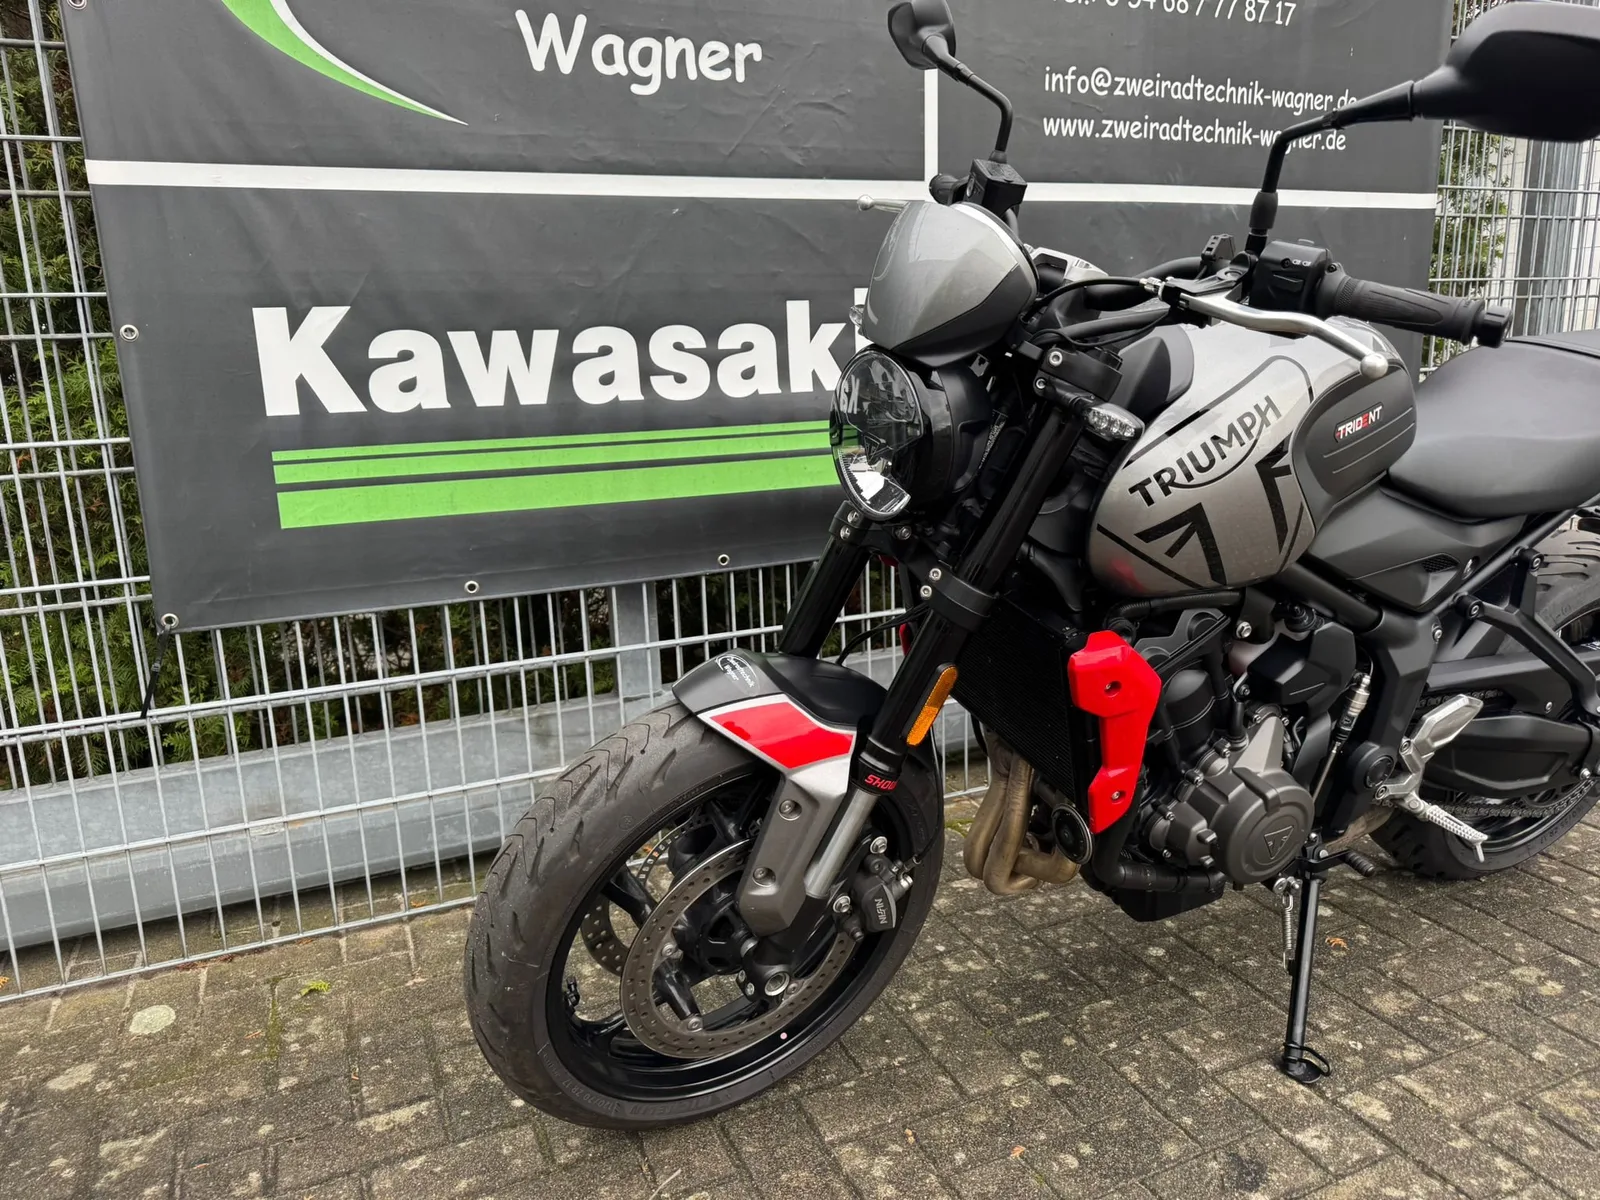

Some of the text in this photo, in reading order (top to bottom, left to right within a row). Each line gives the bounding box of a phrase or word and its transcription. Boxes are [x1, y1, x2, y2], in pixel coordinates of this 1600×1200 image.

[1244, 0, 1270, 23] 87
[1275, 1, 1297, 26] 17
[514, 9, 762, 95] Wagner
[1042, 114, 1346, 154] www.zweiradtechnik-wner.de
[1336, 405, 1383, 440] TRIDENT
[1128, 394, 1282, 507] TRIUMPH
